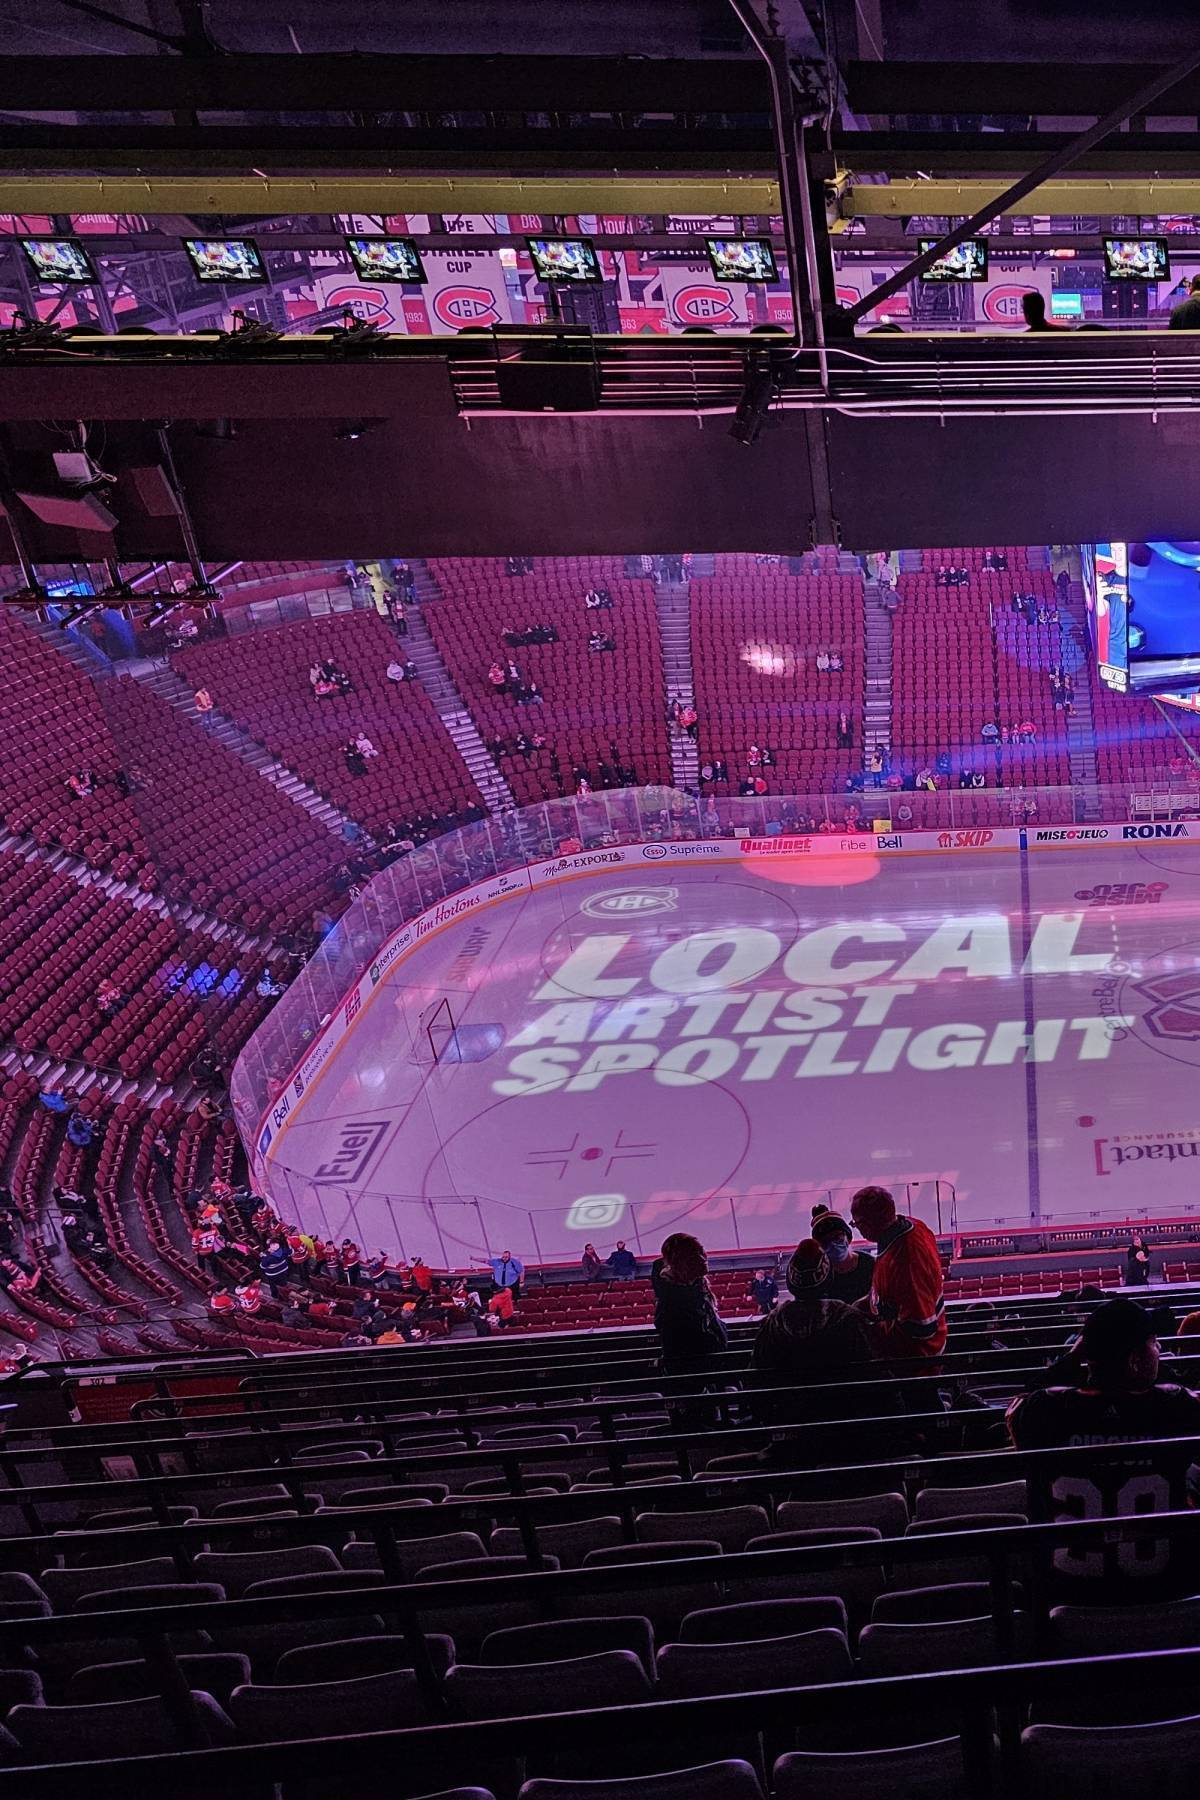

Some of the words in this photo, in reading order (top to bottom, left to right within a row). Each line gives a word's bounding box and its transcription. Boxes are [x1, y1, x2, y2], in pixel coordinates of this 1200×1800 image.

[447, 262, 472, 273] CUP
[404, 312, 424, 323] 1982
[953, 831, 994, 848] SKIP
[1123, 824, 1189, 839] RONA
[670, 844, 720, 856] Suprême
[741, 837, 812, 853] Qualinet
[840, 840, 867, 850] Fibe
[877, 836, 902, 849] Bell
[574, 852, 613, 868] EXPORT
[435, 893, 481, 924] Hortons
[533, 913, 1117, 1001] LOCAL
[506, 984, 917, 1048] ARTIST
[492, 1014, 1136, 1096] SPOTLIGHT
[273, 1096, 291, 1130] Bell
